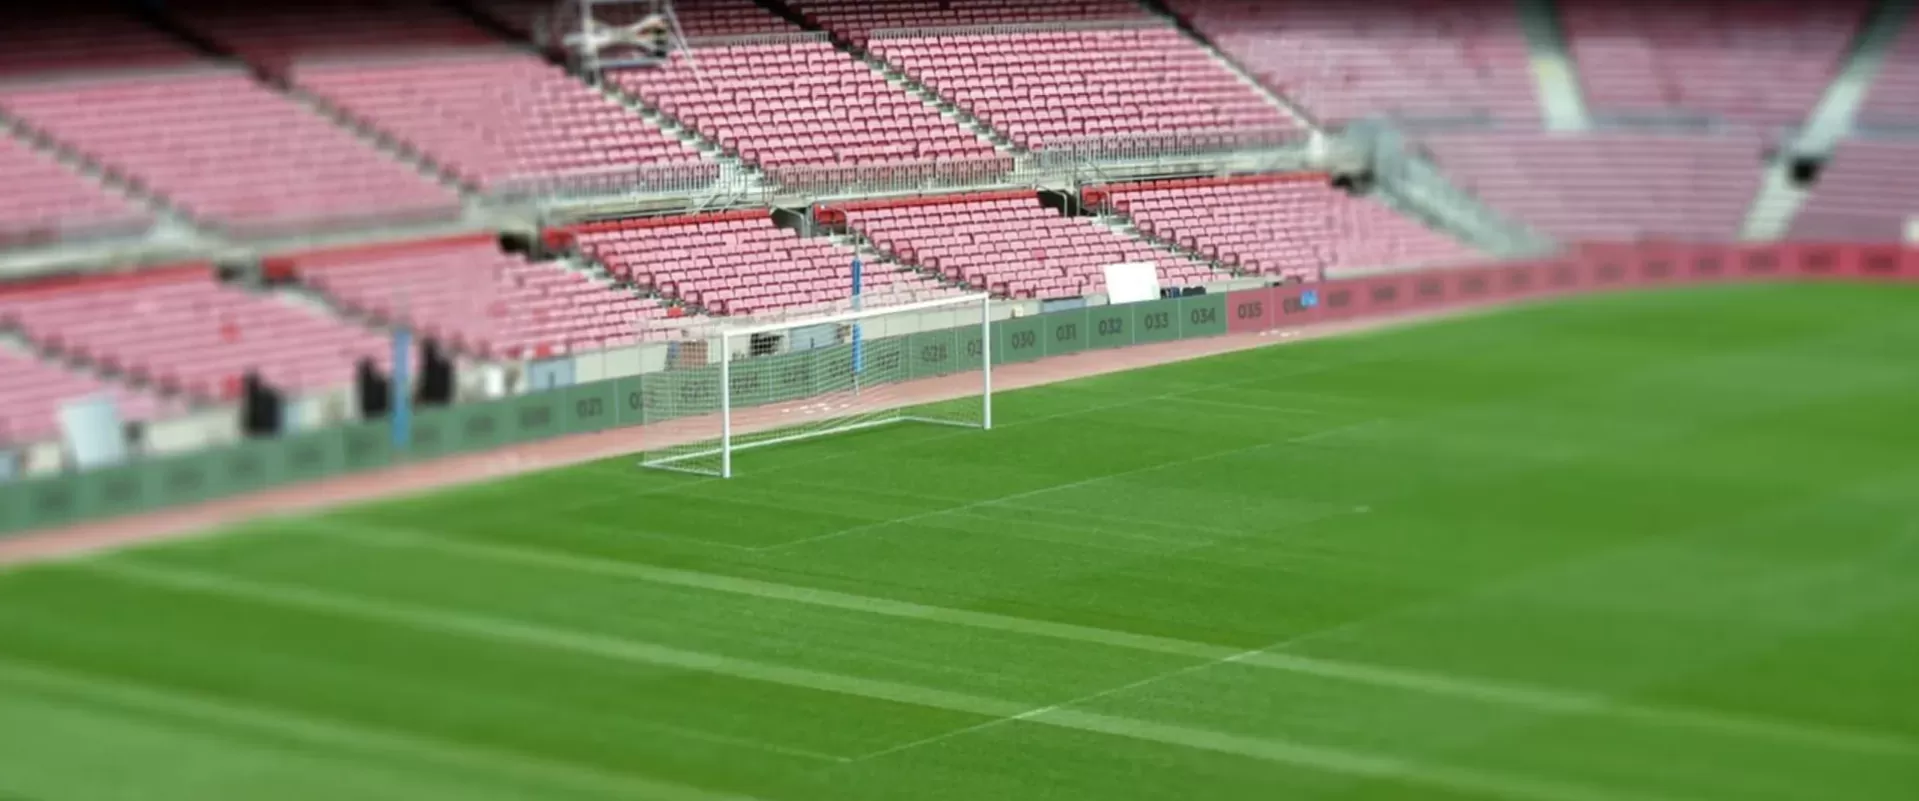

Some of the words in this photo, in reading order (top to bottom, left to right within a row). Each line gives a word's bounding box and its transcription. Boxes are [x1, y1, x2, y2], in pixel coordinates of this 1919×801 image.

[1190, 307, 1216, 325] 034
[1238, 301, 1262, 319] 035
[1098, 316, 1122, 336] 032
[1144, 311, 1169, 330] 033
[1011, 329, 1035, 349] 030
[1055, 323, 1077, 342] 031
